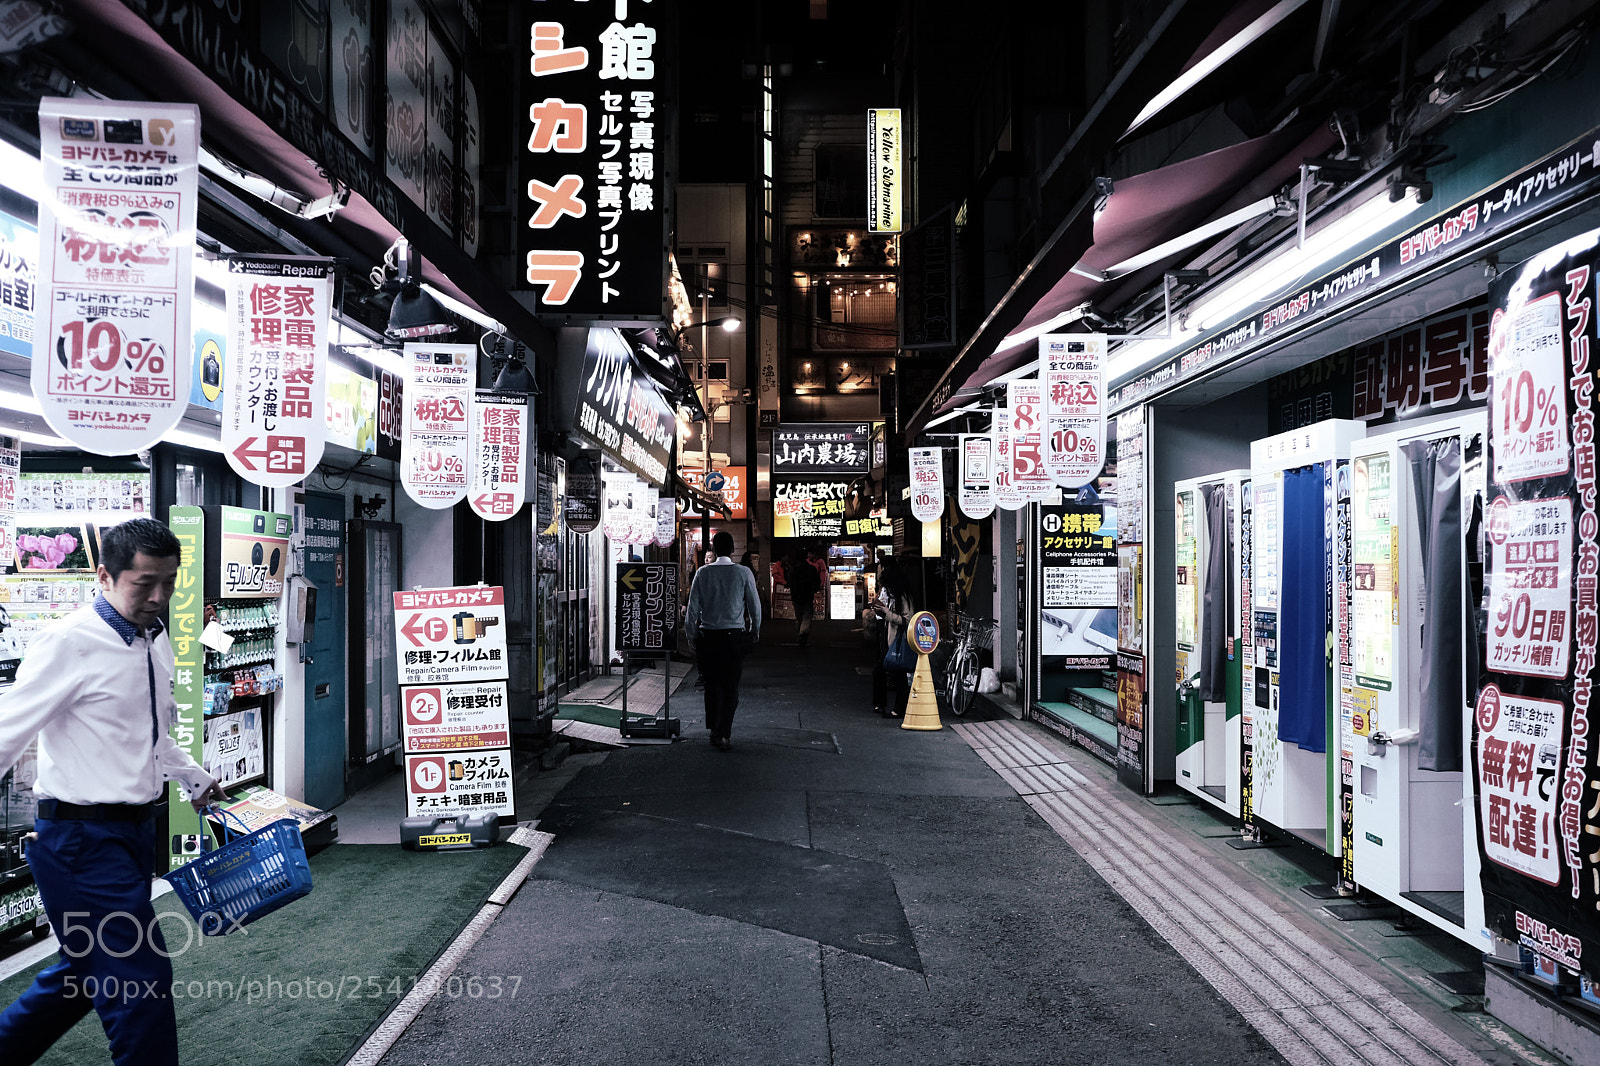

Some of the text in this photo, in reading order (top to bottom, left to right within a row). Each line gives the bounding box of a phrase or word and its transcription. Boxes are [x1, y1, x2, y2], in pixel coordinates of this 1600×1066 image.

[61, 145, 178, 164] ヨドバシカメラは
[527, 0, 589, 305] シカメラ
[628, 91, 655, 211] 写真現像
[63, 164, 178, 186] 全ての商品が
[882, 127, 894, 228] Yellow Submarine
[598, 90, 623, 303] セルフ写真プリント
[1400, 204, 1479, 265] ヨドバシカメラ
[282, 264, 323, 279] Repair
[77, 306, 150, 318] ご利用でさらに
[250, 283, 282, 350] 修理
[1262, 291, 1310, 332] ヨドバシカメラ
[61, 320, 164, 374] 10%
[282, 284, 316, 418] 家電製品
[1049, 362, 1099, 370] 全ての商品が
[56, 373, 170, 397] ポイント還元
[247, 351, 262, 423] カウンター
[1052, 384, 1098, 406] 税込
[416, 398, 465, 422] 税込
[1501, 370, 1558, 435] 10%
[68, 410, 151, 424] ヨドバシカメラ
[483, 407, 502, 444] 修理
[762, 414, 775, 423] 2F
[1014, 404, 1040, 431] 8
[855, 426, 867, 435] 4F
[502, 407, 520, 483] 家電製品
[1052, 430, 1096, 453] 10%
[1502, 429, 1561, 459] ポイント還元!
[269, 451, 303, 470] 2F
[776, 442, 857, 466] 山内農場
[1051, 453, 1098, 463] ポイント還元
[482, 445, 490, 486] カウンター
[413, 473, 465, 483] ポイント還元
[723, 476, 739, 489] 24
[915, 471, 938, 482] 税込
[494, 502, 513, 513] 2F
[725, 502, 743, 510] PEN
[1062, 513, 1101, 534] 携帯
[1044, 536, 1113, 549] アクセサリー館
[402, 591, 494, 607] ヨドバシカメラ
[645, 566, 664, 648] プリント館
[665, 567, 676, 630] ヨドバシカメラ
[622, 593, 631, 647] セルフプリント
[1494, 592, 1566, 642] 90日間
[430, 620, 443, 639] F
[404, 648, 502, 666] 修理・フィルム館
[1494, 643, 1560, 667] ガッチリ補償!
[406, 666, 459, 675] Repair/Camera
[477, 686, 502, 695] Repair
[416, 698, 434, 714] 2F
[446, 694, 503, 710] 修理受付
[1483, 706, 1494, 727] 3
[1503, 704, 1555, 724] ご希望に合わせた
[1508, 720, 1548, 738] 日時にお届け
[465, 756, 500, 770] カメラ
[421, 767, 437, 782] 1F
[465, 768, 510, 781] フィルム
[449, 783, 475, 791] Camera
[416, 791, 508, 807] チェキ・暗室用品
[420, 835, 470, 845] ヨドバシカメラ
[1516, 910, 1581, 958] ヨドバシカメラ
